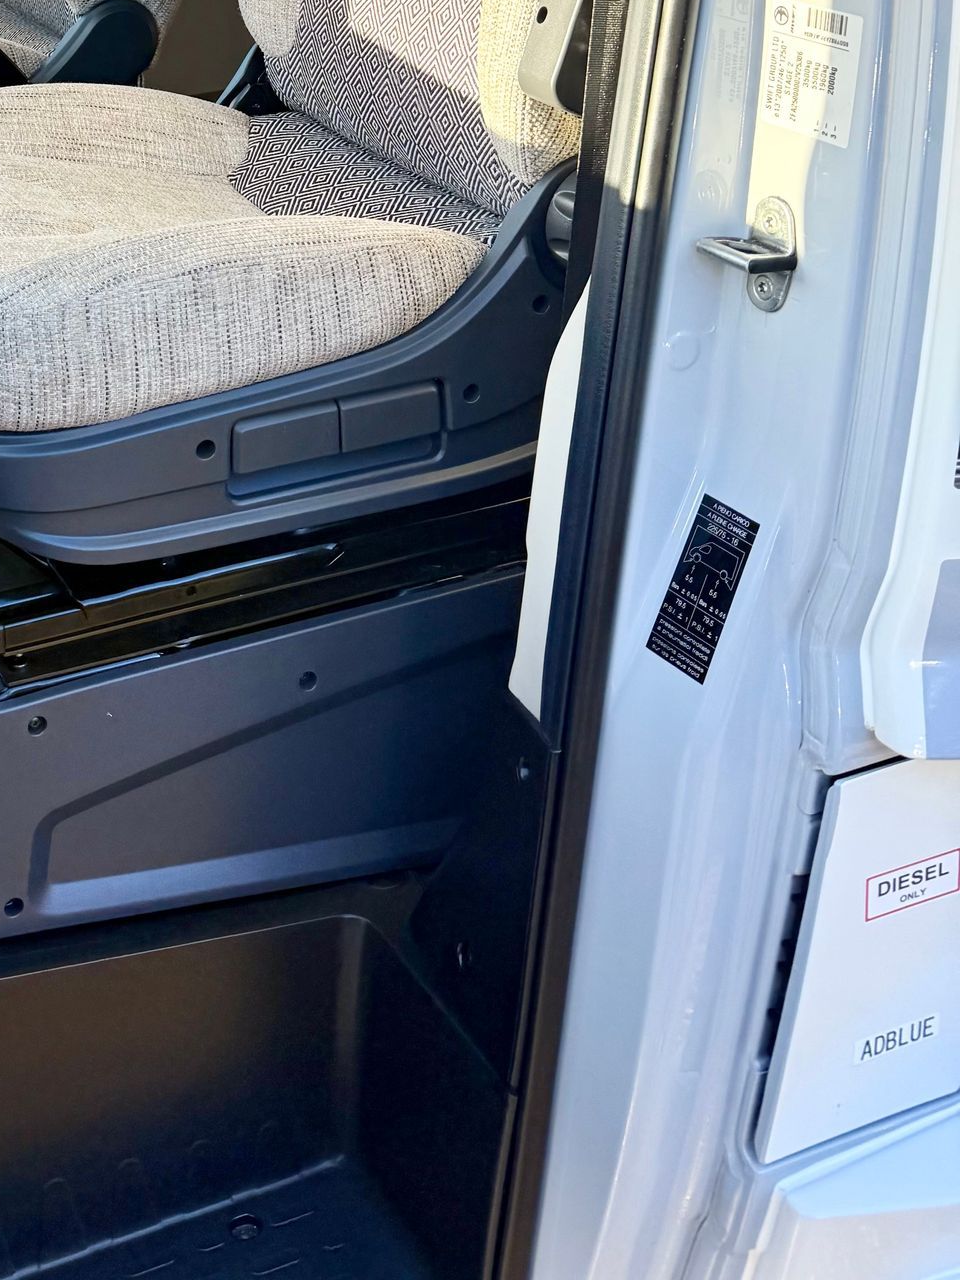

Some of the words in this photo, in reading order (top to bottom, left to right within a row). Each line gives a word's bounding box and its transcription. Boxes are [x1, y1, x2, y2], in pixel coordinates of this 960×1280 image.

[769, 54, 777, 81] GROUP
[802, 60, 812, 87] 3500kg
[819, 64, 829, 91] 1960kg
[827, 66, 838, 95] 2000kg
[784, 70, 793, 95] STAGE
[765, 84, 774, 109] SWIFT
[730, 536, 740, 547] 16
[702, 615, 715, 627] 79.5
[877, 862, 949, 898] DIESEL
[899, 887, 927, 903] ONLY
[860, 1016, 935, 1061] ADBLUE
